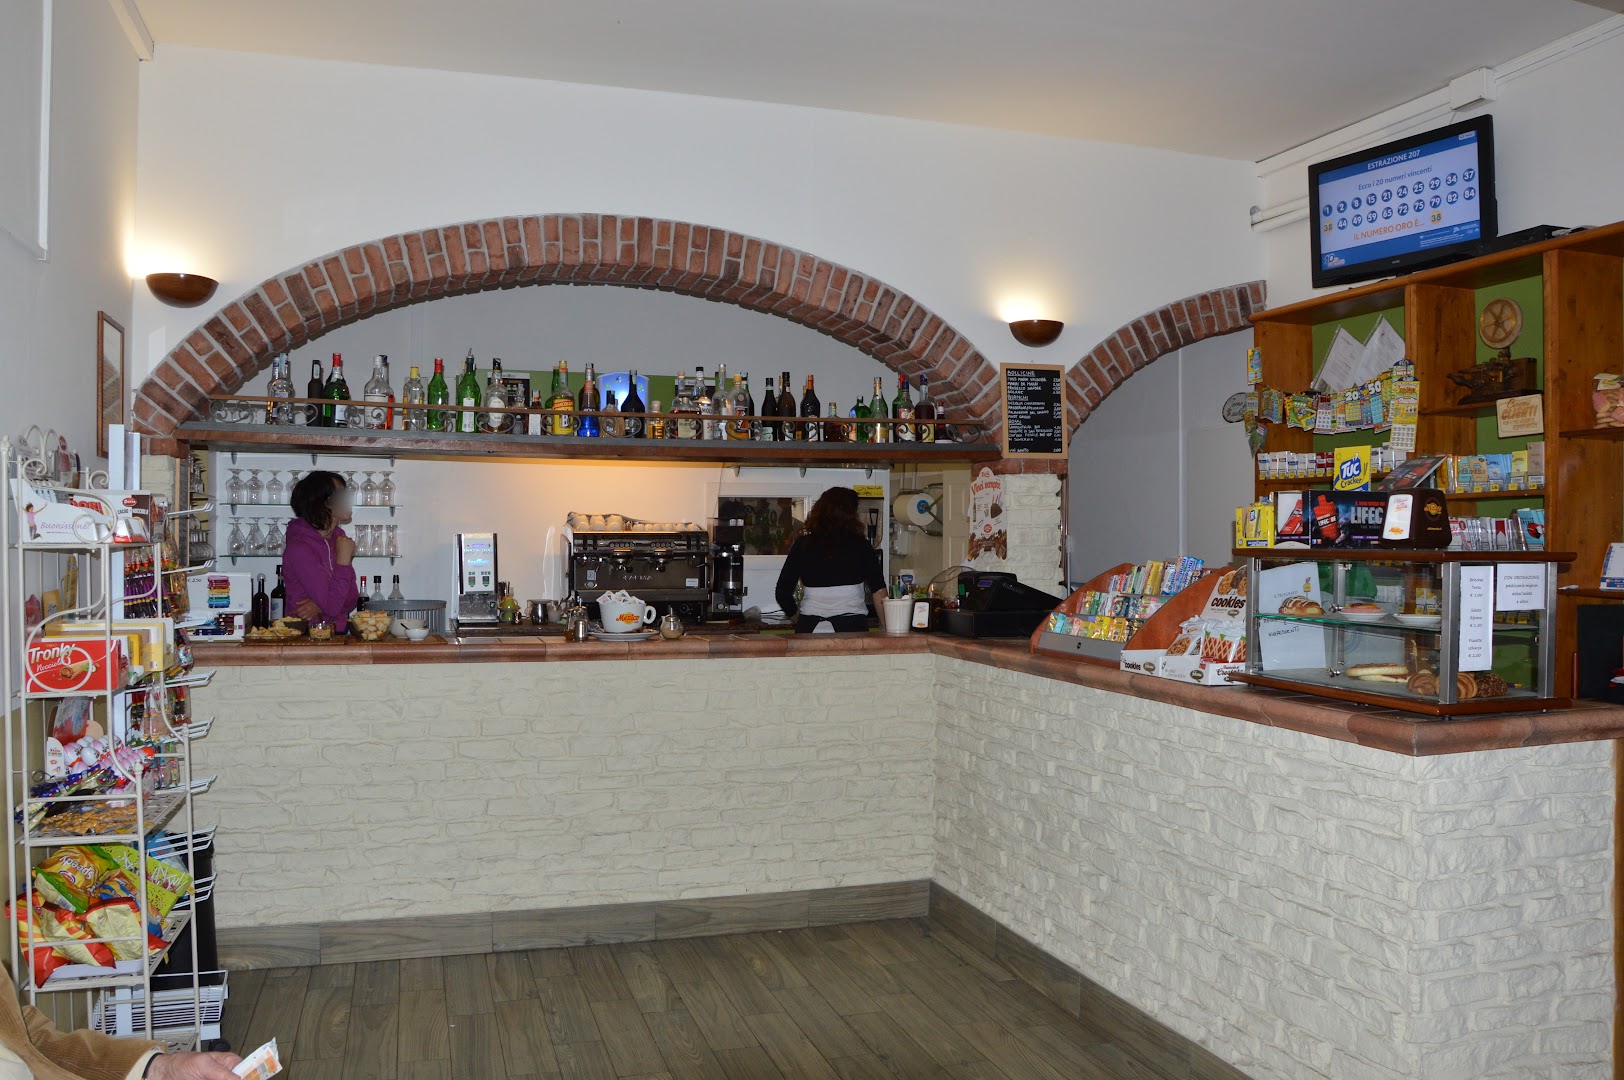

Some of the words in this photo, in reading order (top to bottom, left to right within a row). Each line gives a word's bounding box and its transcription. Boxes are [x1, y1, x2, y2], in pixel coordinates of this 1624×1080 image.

[1367, 153, 1408, 170] ESTRAZIONE
[1408, 149, 1421, 159] 207
[1358, 183, 1372, 191] Ecco
[1384, 172, 1407, 183] numeri
[1407, 165, 1433, 178] vincenti
[1368, 195, 1375, 204] 15
[1383, 191, 1391, 200] 21
[1397, 187, 1407, 196] 24
[1413, 183, 1423, 192] 25
[1430, 179, 1440, 188] 29
[1446, 175, 1457, 184] 34
[1463, 170, 1474, 180] 37
[1323, 224, 1333, 232] 38
[1338, 220, 1347, 228] 44
[1352, 216, 1362, 225] 49
[1367, 212, 1377, 221] 59
[1383, 208, 1392, 218] 65
[1399, 206, 1408, 214] 72
[1414, 201, 1424, 210] 75
[1430, 197, 1441, 207] 79
[1447, 193, 1458, 202] 82
[1464, 189, 1475, 198] 84
[1360, 225, 1394, 239] NUMERO
[1395, 220, 1413, 232] ORO
[1431, 213, 1442, 222] 38
[1345, 391, 1359, 401] 20
[1367, 380, 1381, 395] 50
[1341, 461, 1360, 479] TUC
[1340, 477, 1362, 489] Cracker
[1351, 506, 1384, 525] LIFEC
[1211, 596, 1246, 609] cookies
[616, 613, 640, 621] Mexico
[1124, 662, 1141, 671] cookies
[60, 855, 95, 880] Speedy
